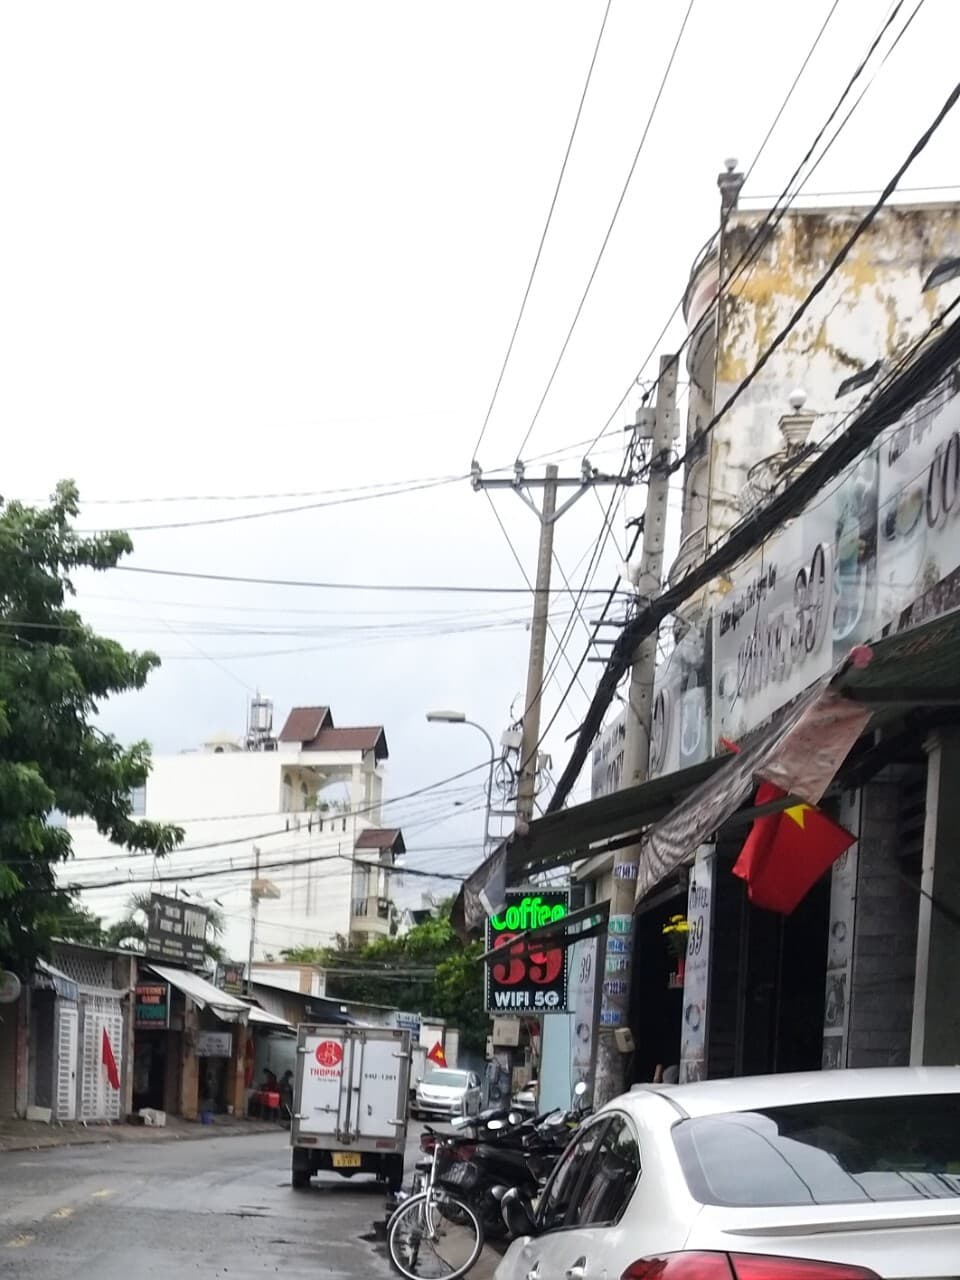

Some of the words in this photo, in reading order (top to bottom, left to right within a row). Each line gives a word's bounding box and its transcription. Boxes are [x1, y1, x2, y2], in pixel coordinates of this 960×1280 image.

[491, 897, 565, 931] Coffee
[689, 915, 704, 956] 39
[493, 933, 563, 985] 39
[494, 991, 529, 1007] WIFI
[534, 991, 560, 1007] 5G
